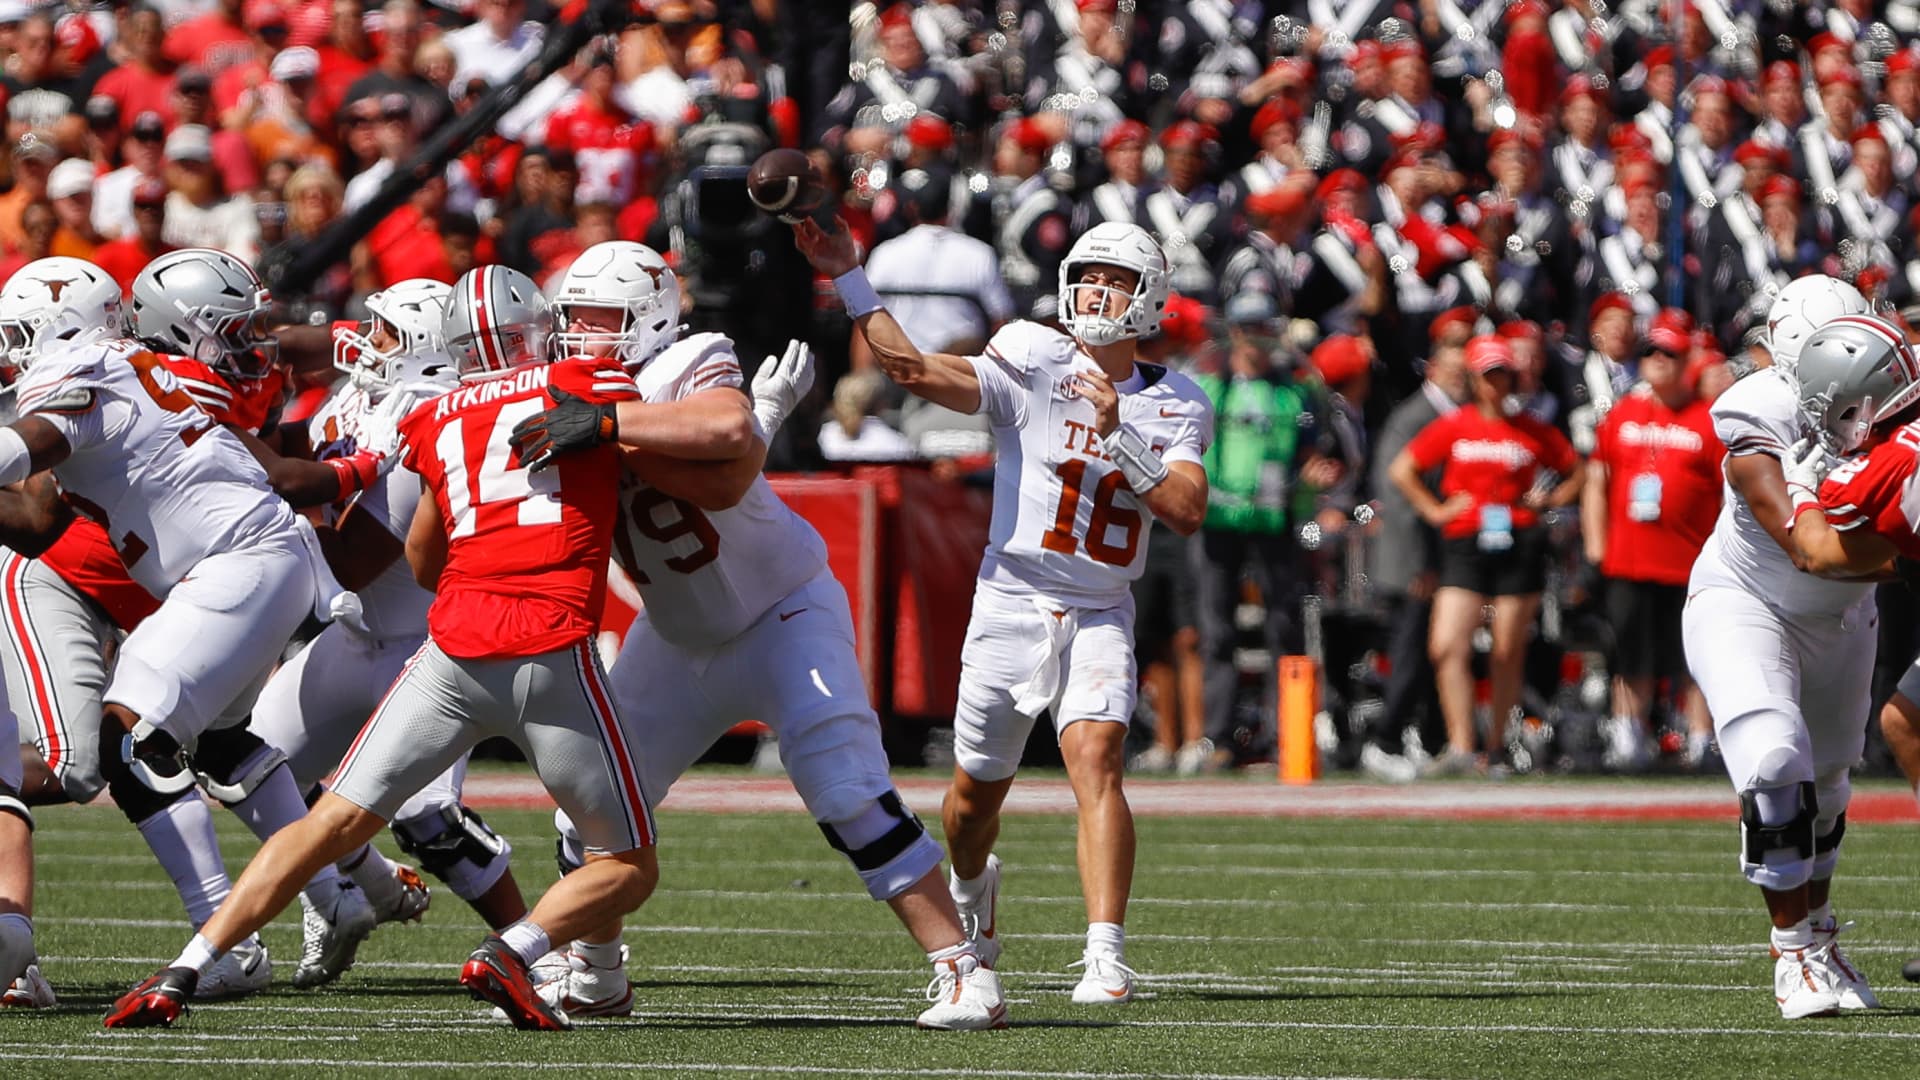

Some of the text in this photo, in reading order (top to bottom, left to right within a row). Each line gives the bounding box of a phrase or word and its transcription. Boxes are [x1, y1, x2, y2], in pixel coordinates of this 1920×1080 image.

[435, 366, 549, 421] ATKINSON
[436, 397, 563, 541] 14
[1041, 458, 1142, 567] 16
